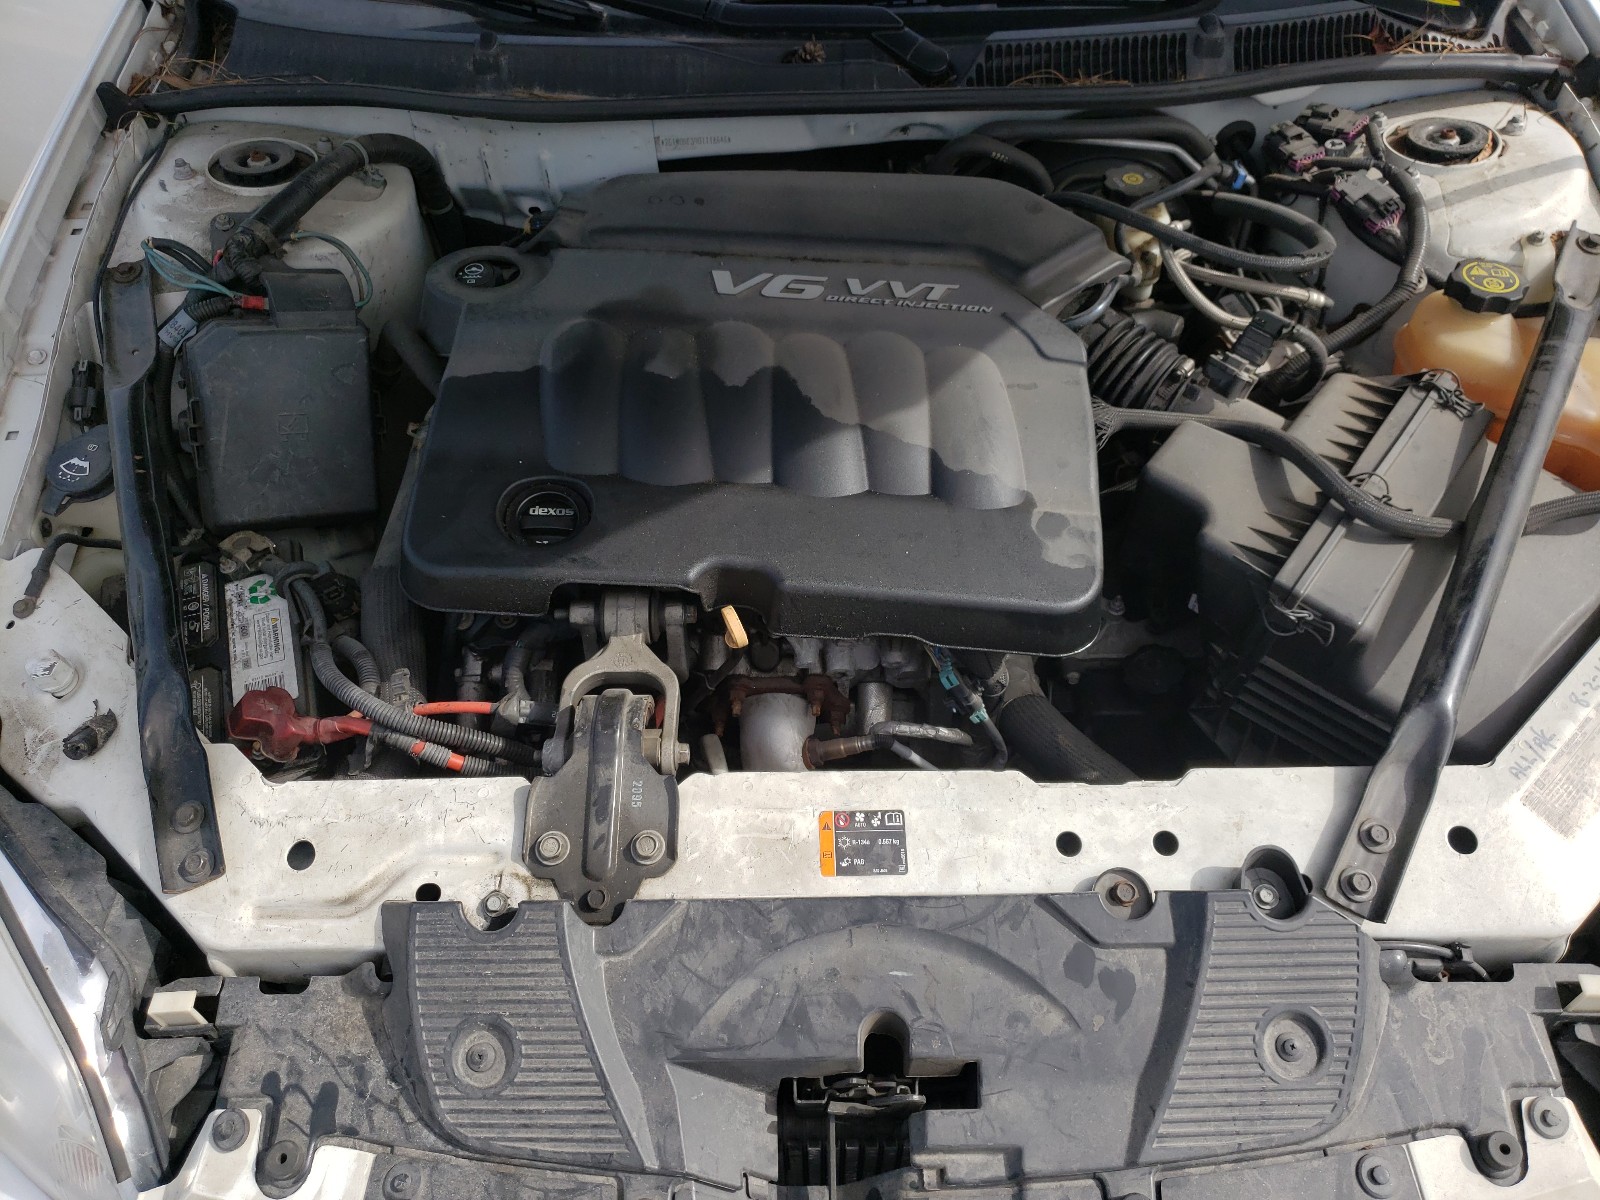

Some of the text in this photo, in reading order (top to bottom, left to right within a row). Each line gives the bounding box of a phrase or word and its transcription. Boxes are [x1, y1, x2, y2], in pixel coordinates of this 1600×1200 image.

[711, 269, 960, 301] V6 VVT
[825, 294, 994, 313] DIRECT INJECTION
[528, 505, 575, 516] dexos
[631, 780, 644, 808] 2095
